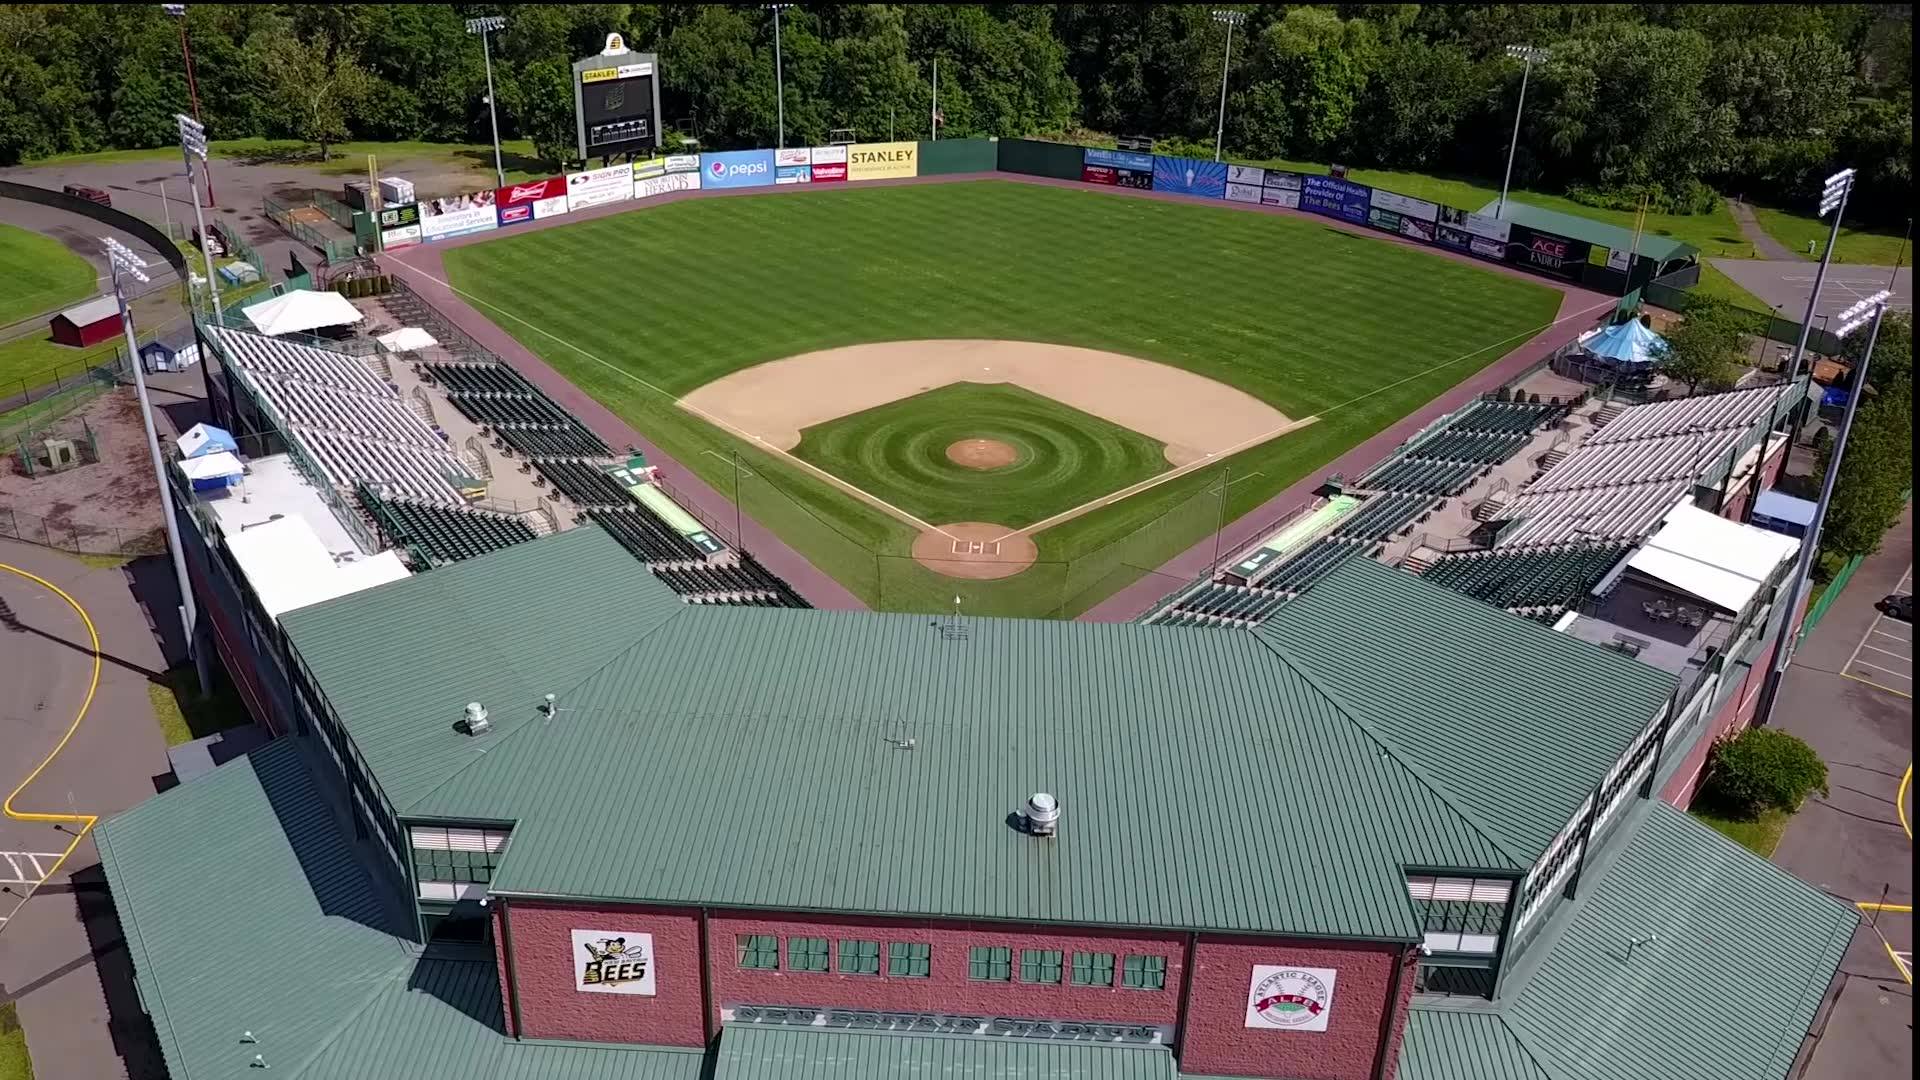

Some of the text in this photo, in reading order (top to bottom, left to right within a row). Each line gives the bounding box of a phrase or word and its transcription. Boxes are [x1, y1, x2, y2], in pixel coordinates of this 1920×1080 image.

[584, 69, 615, 80] STANLEY
[851, 150, 913, 164] STANLEY
[592, 171, 611, 180] SIGN
[613, 167, 630, 176] PRO
[729, 160, 767, 178] pepsi
[644, 180, 689, 196] HERALD
[1305, 186, 1335, 198] Provider
[1335, 193, 1345, 201] Of
[1307, 178, 1321, 187] The
[1322, 180, 1346, 192] Official
[1346, 186, 1368, 198] Health
[1304, 196, 1321, 207] The
[1322, 198, 1341, 211] Bees
[466, 215, 493, 226] Services
[1532, 240, 1567, 255] ACE
[1530, 252, 1563, 268] ENDICO
[583, 961, 647, 985] BEES
[1257, 972, 1325, 1001] ATLANTIC LEAGUE
[1267, 995, 1314, 1007] ALPB
[735, 1005, 1160, 1042] NEW BRITAIN STADIUM
